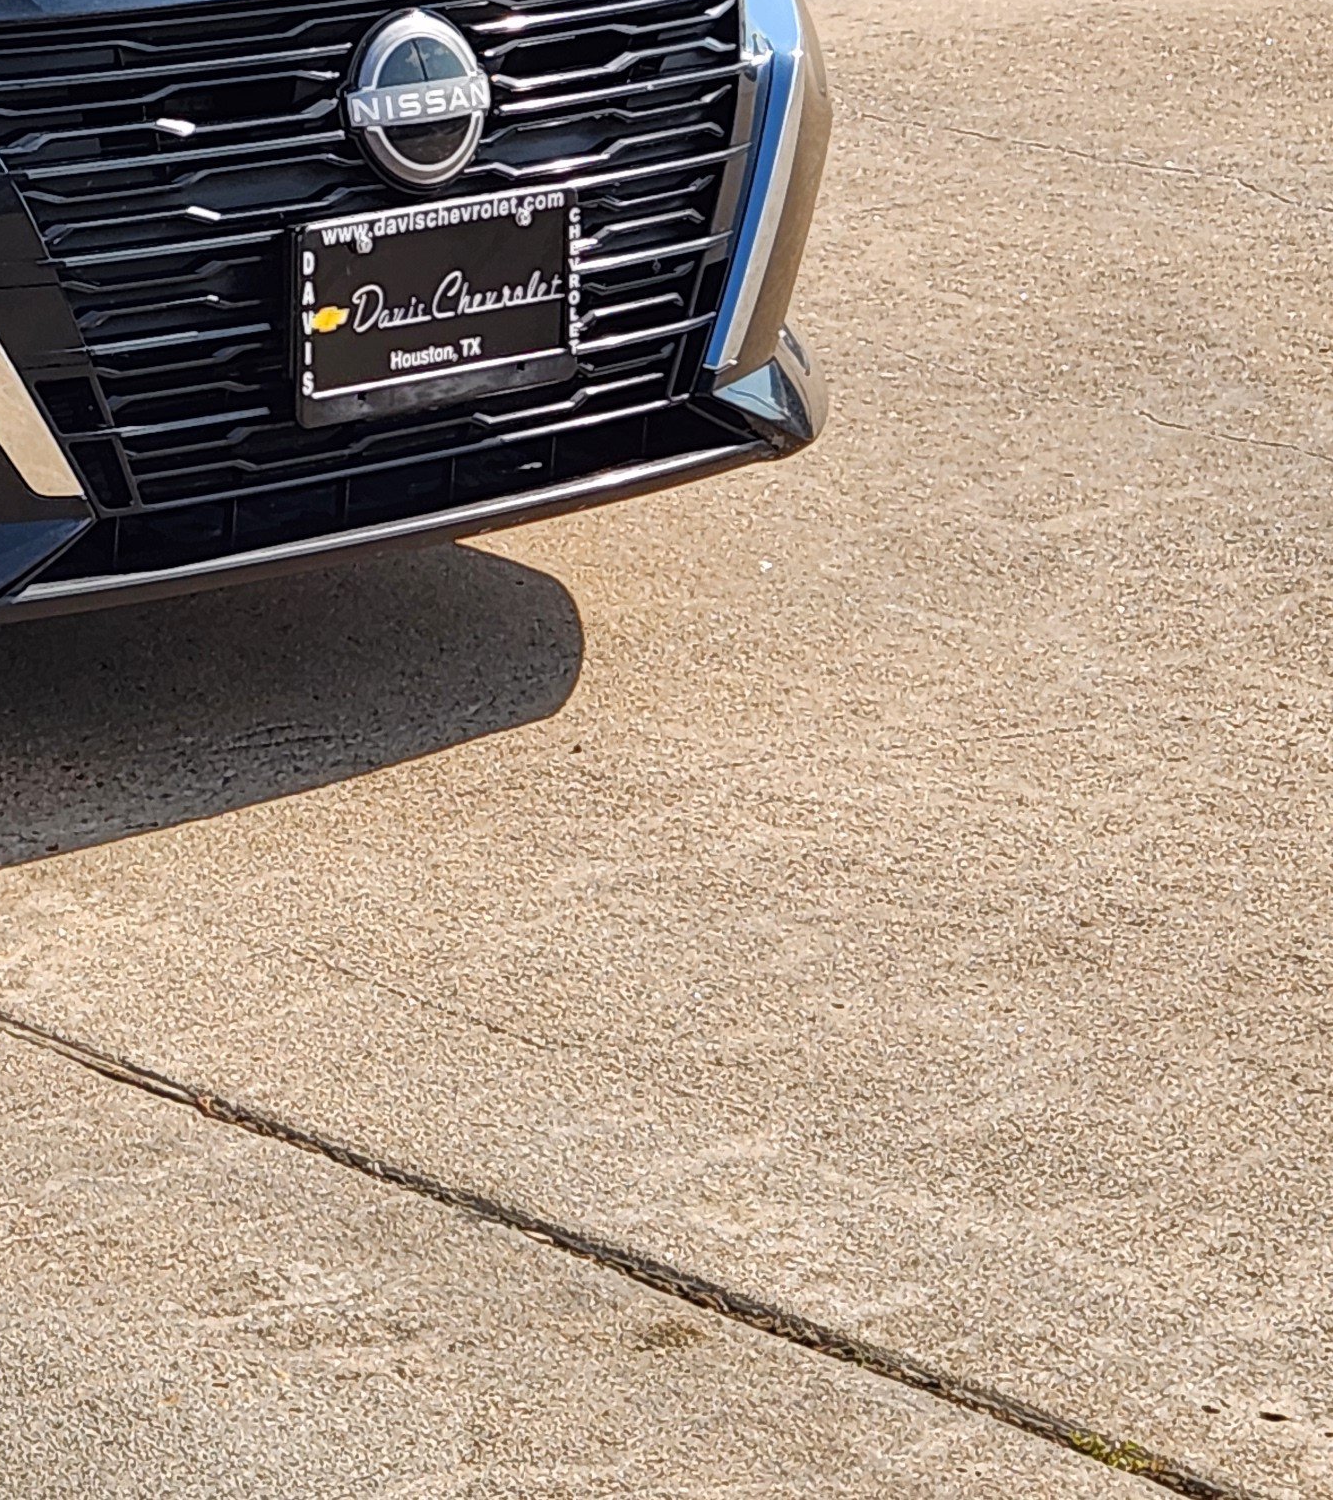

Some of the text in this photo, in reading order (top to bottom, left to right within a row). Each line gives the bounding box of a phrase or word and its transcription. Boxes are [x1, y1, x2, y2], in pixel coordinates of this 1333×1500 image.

[351, 82, 488, 123] NISSAN
[320, 191, 565, 246] www.davischevrolet.com
[301, 250, 316, 396] DAVIS
[351, 270, 566, 333] Davis Chevrolet
[389, 336, 482, 370] Houston, TX
